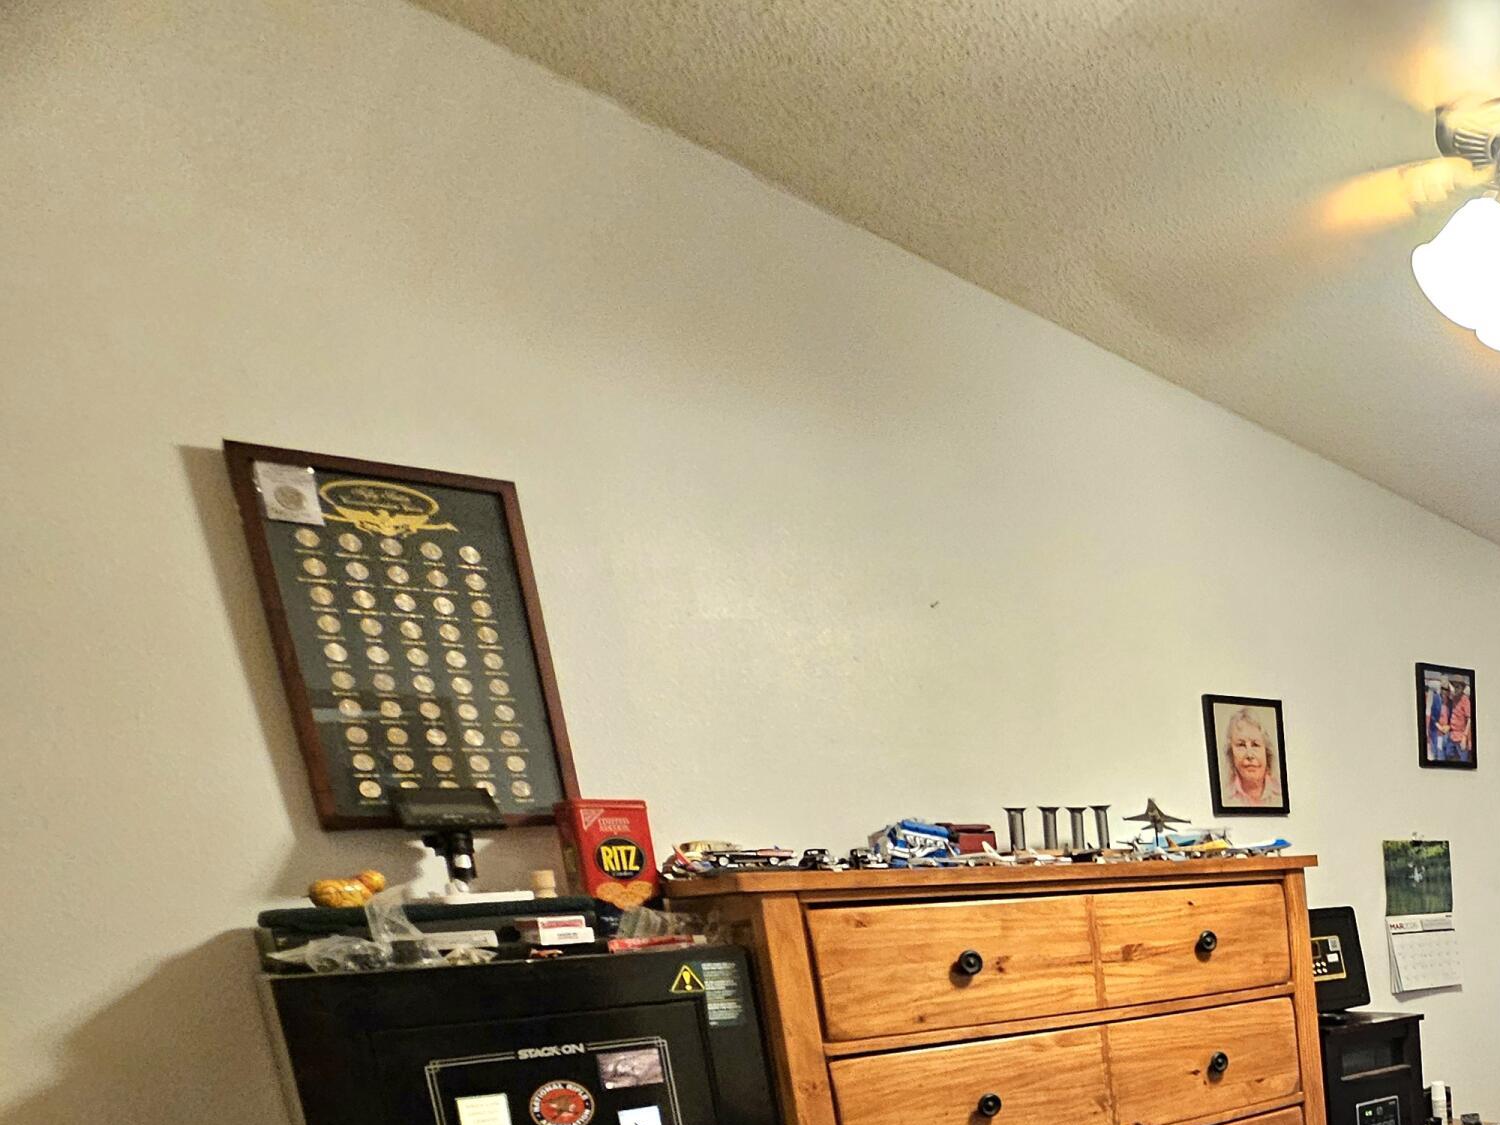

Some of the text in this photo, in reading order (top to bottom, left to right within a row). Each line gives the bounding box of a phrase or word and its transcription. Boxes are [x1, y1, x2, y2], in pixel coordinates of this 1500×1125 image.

[600, 845, 640, 872] RITZ
[533, 1083, 590, 1113] NATIONAL RIFLE
